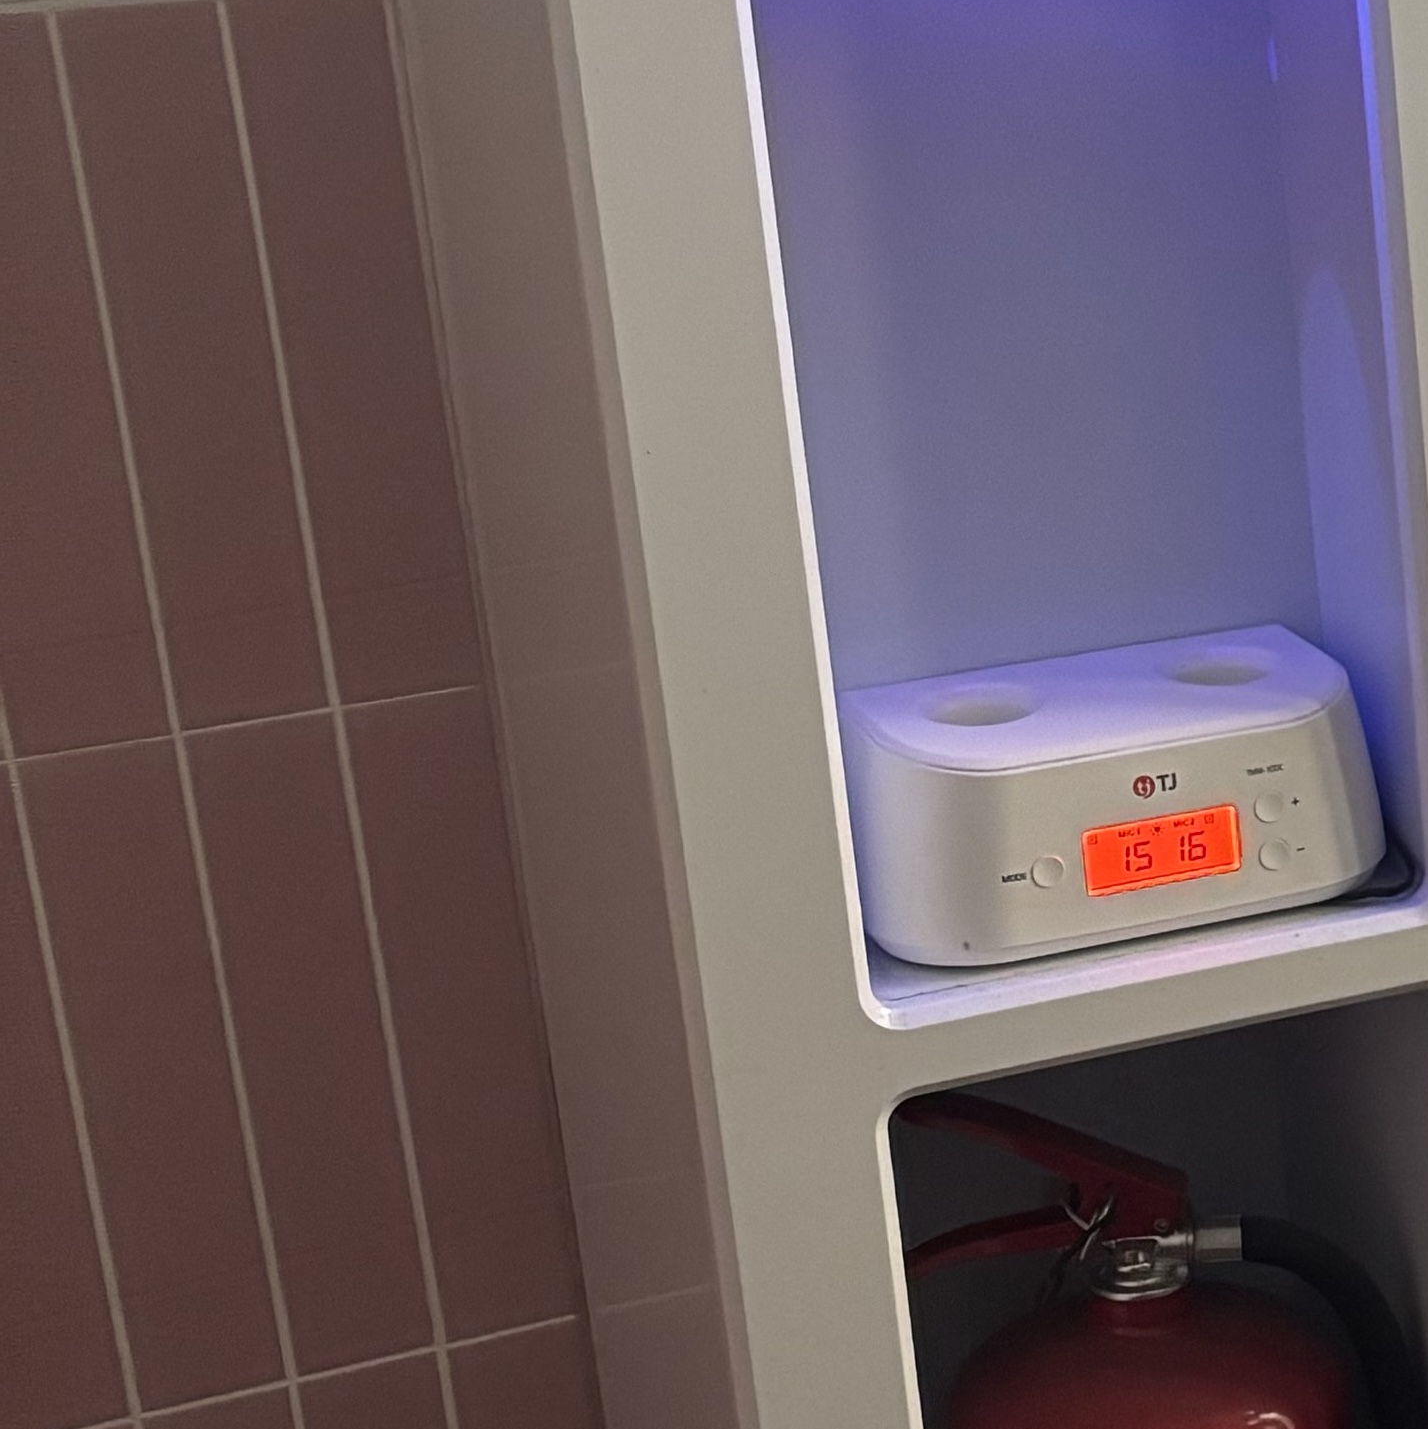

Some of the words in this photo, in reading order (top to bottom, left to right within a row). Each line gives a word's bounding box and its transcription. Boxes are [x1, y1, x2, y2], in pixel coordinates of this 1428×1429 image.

[1156, 773, 1178, 792] TJ
[1125, 840, 1153, 872] 15
[1180, 830, 1207, 862] 16
